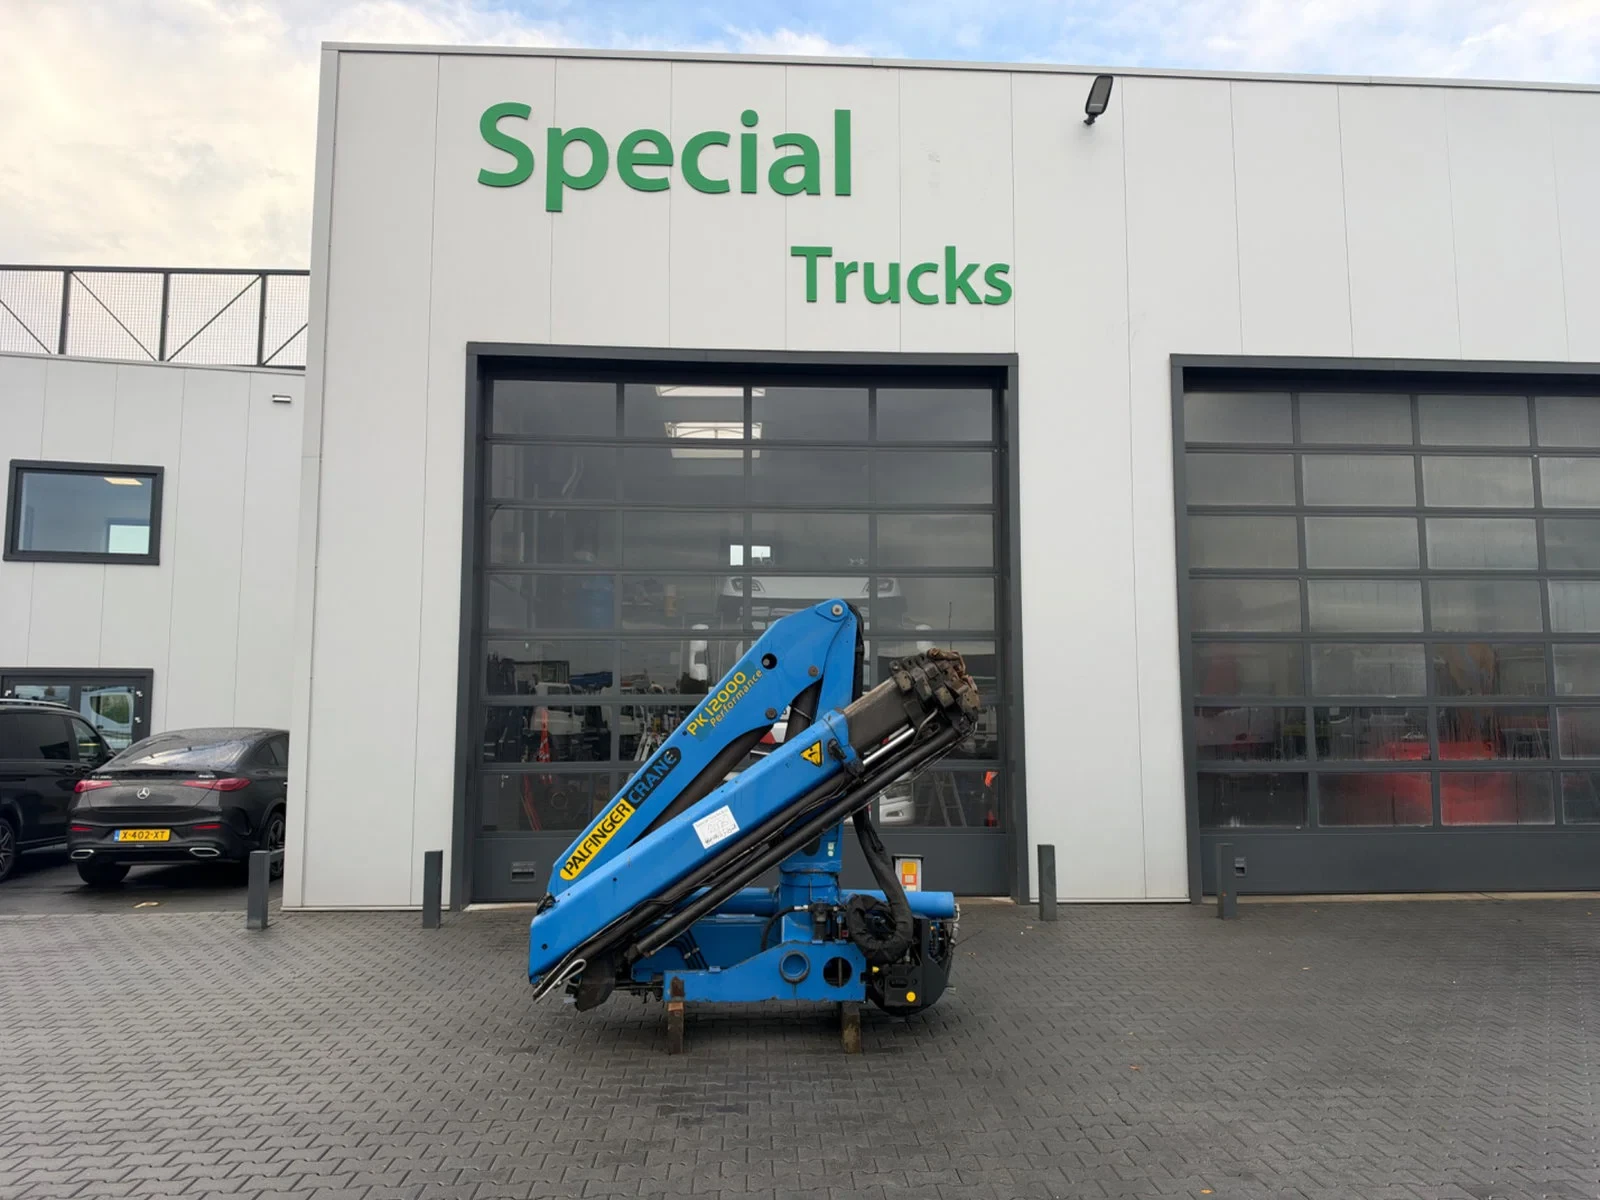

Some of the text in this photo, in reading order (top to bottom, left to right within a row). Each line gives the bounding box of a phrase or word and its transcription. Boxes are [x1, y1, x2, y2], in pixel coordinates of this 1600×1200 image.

[478, 102, 851, 212] Special
[791, 246, 1012, 305] Trucks
[687, 671, 746, 736] PK 12000
[710, 670, 763, 727] Performance
[121, 830, 166, 840] X-402-XT
[563, 751, 677, 876] PALFINGER CRANE
